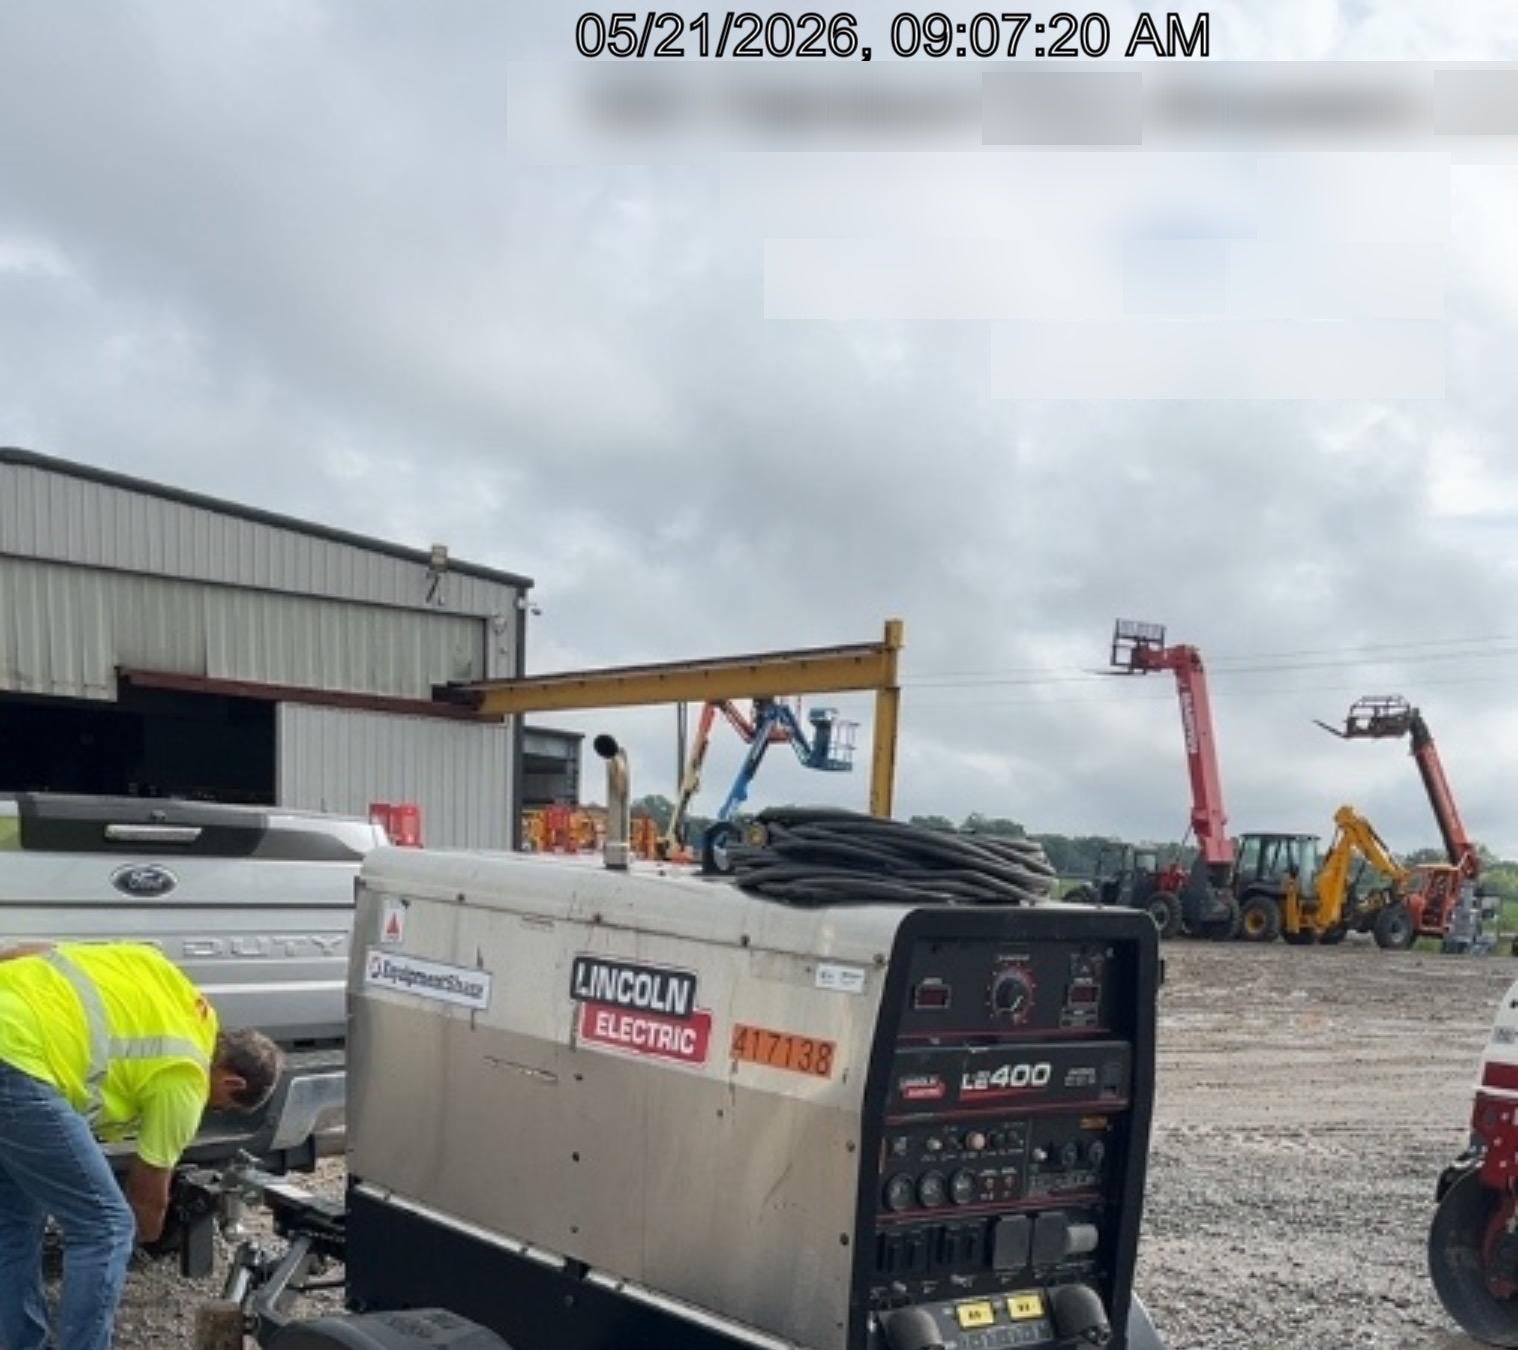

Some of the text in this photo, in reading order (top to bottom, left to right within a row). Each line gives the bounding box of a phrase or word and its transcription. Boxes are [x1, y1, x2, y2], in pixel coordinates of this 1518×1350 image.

[183, 935, 346, 958] DUTY
[575, 961, 690, 1015] LINCOLN
[595, 1010, 697, 1054] ELECTRIC
[733, 1026, 833, 1076] 417138
